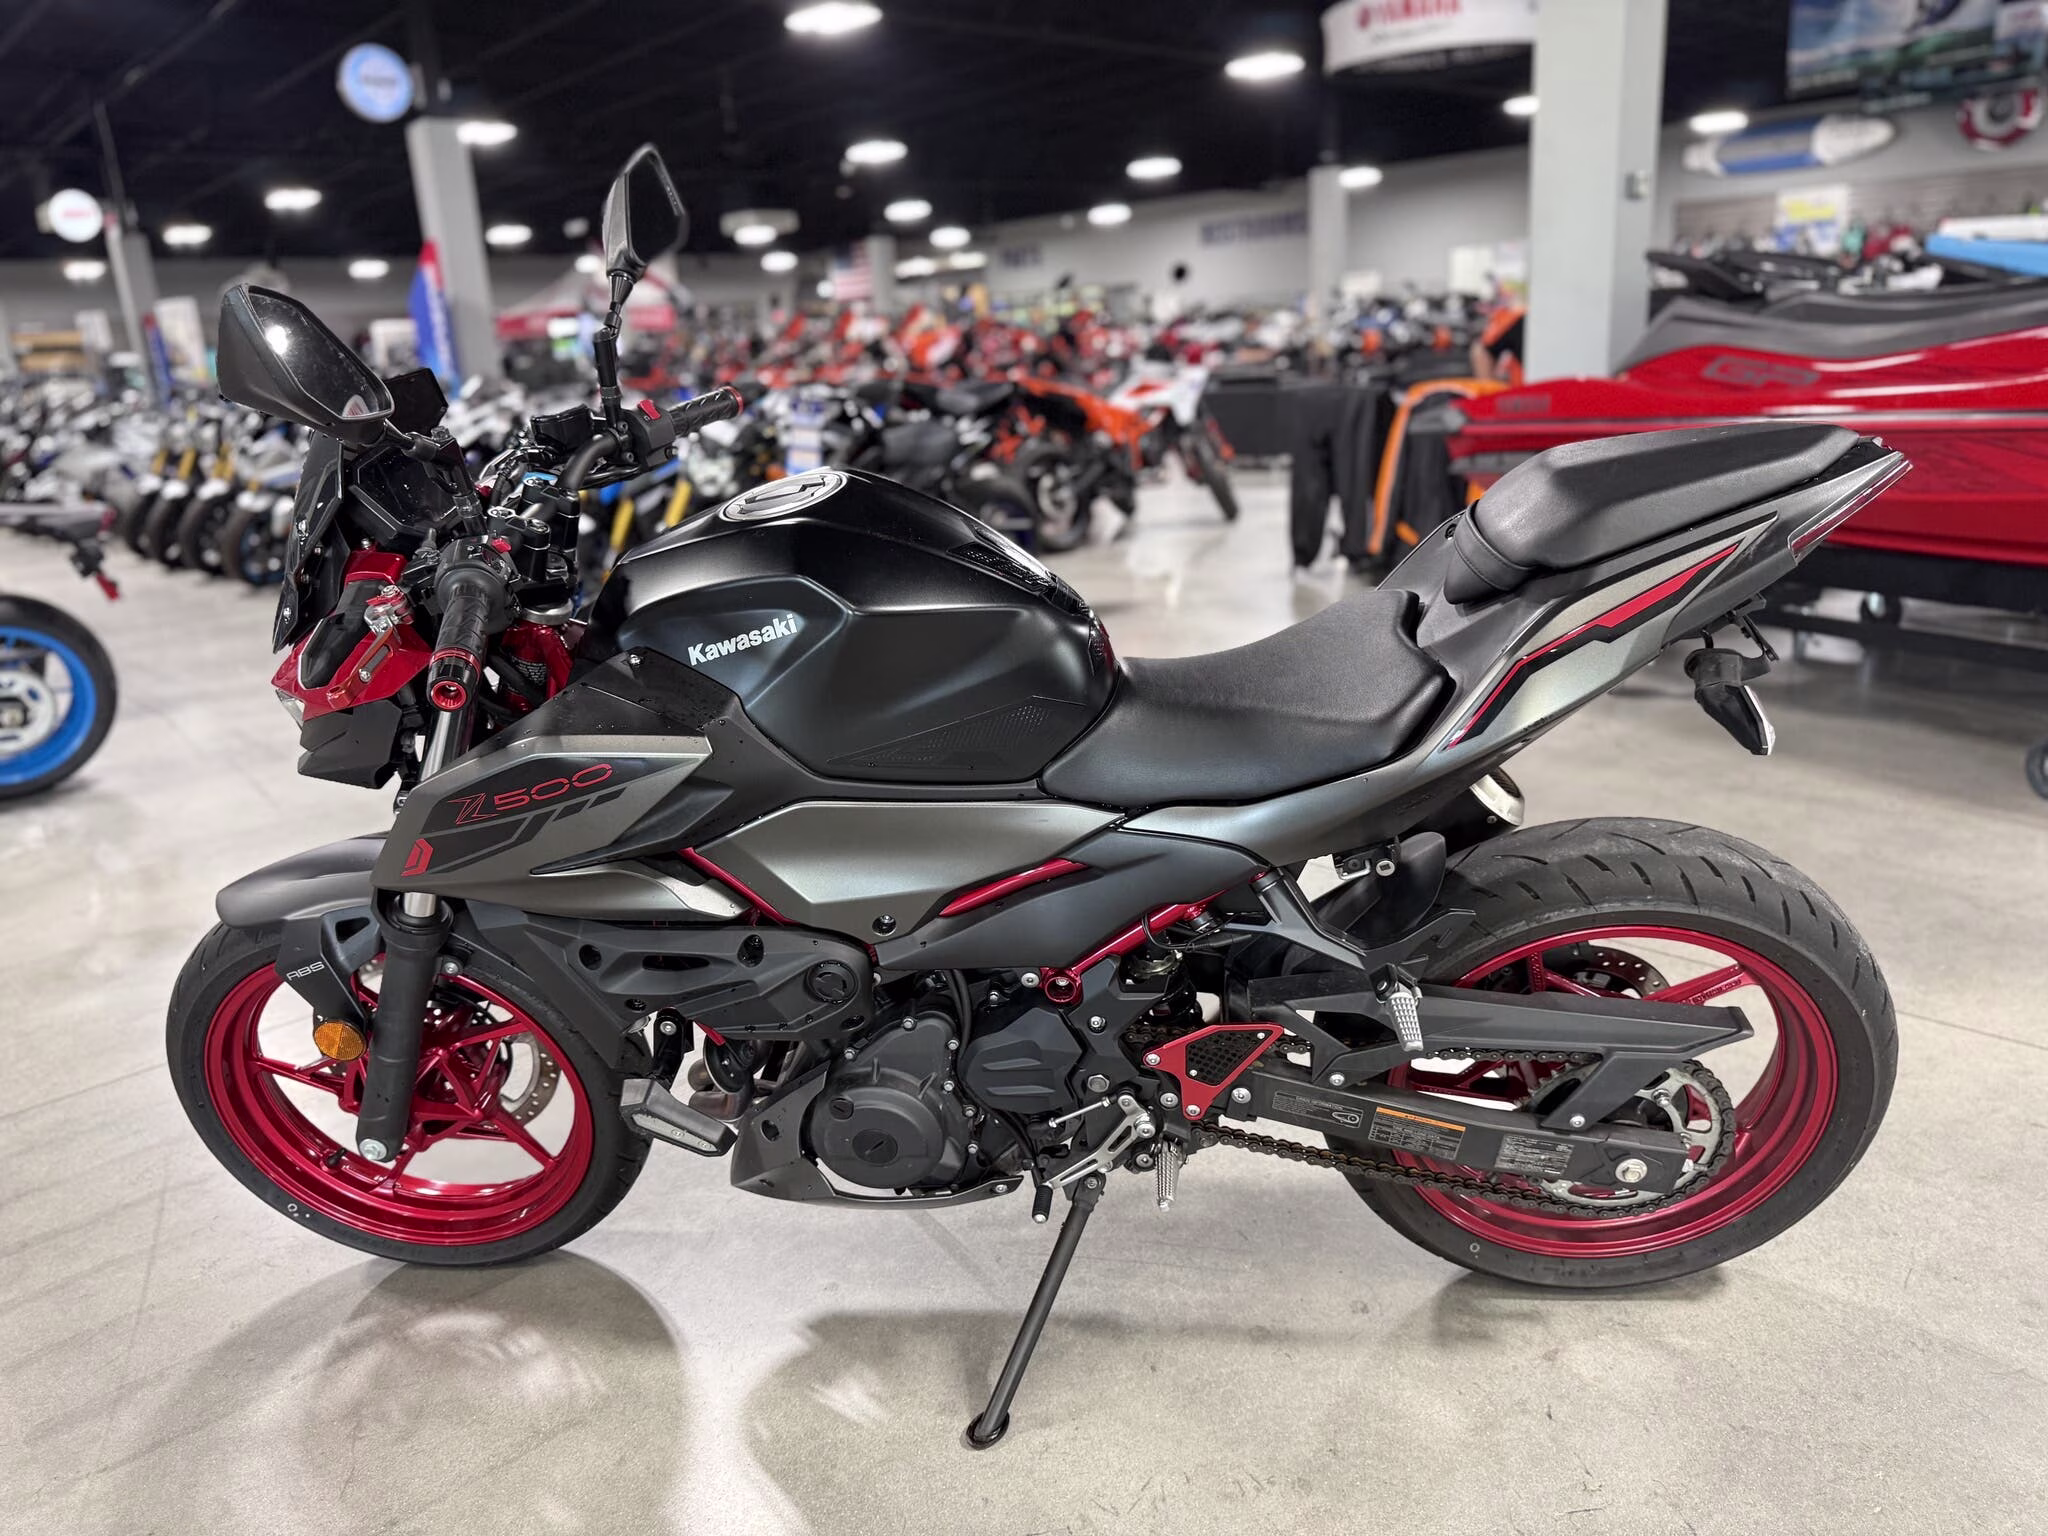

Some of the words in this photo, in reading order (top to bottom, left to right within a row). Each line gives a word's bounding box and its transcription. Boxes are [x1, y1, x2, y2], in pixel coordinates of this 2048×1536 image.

[687, 613, 798, 666] Kawasaki
[447, 763, 613, 825] Z500
[286, 961, 325, 981] ABS
